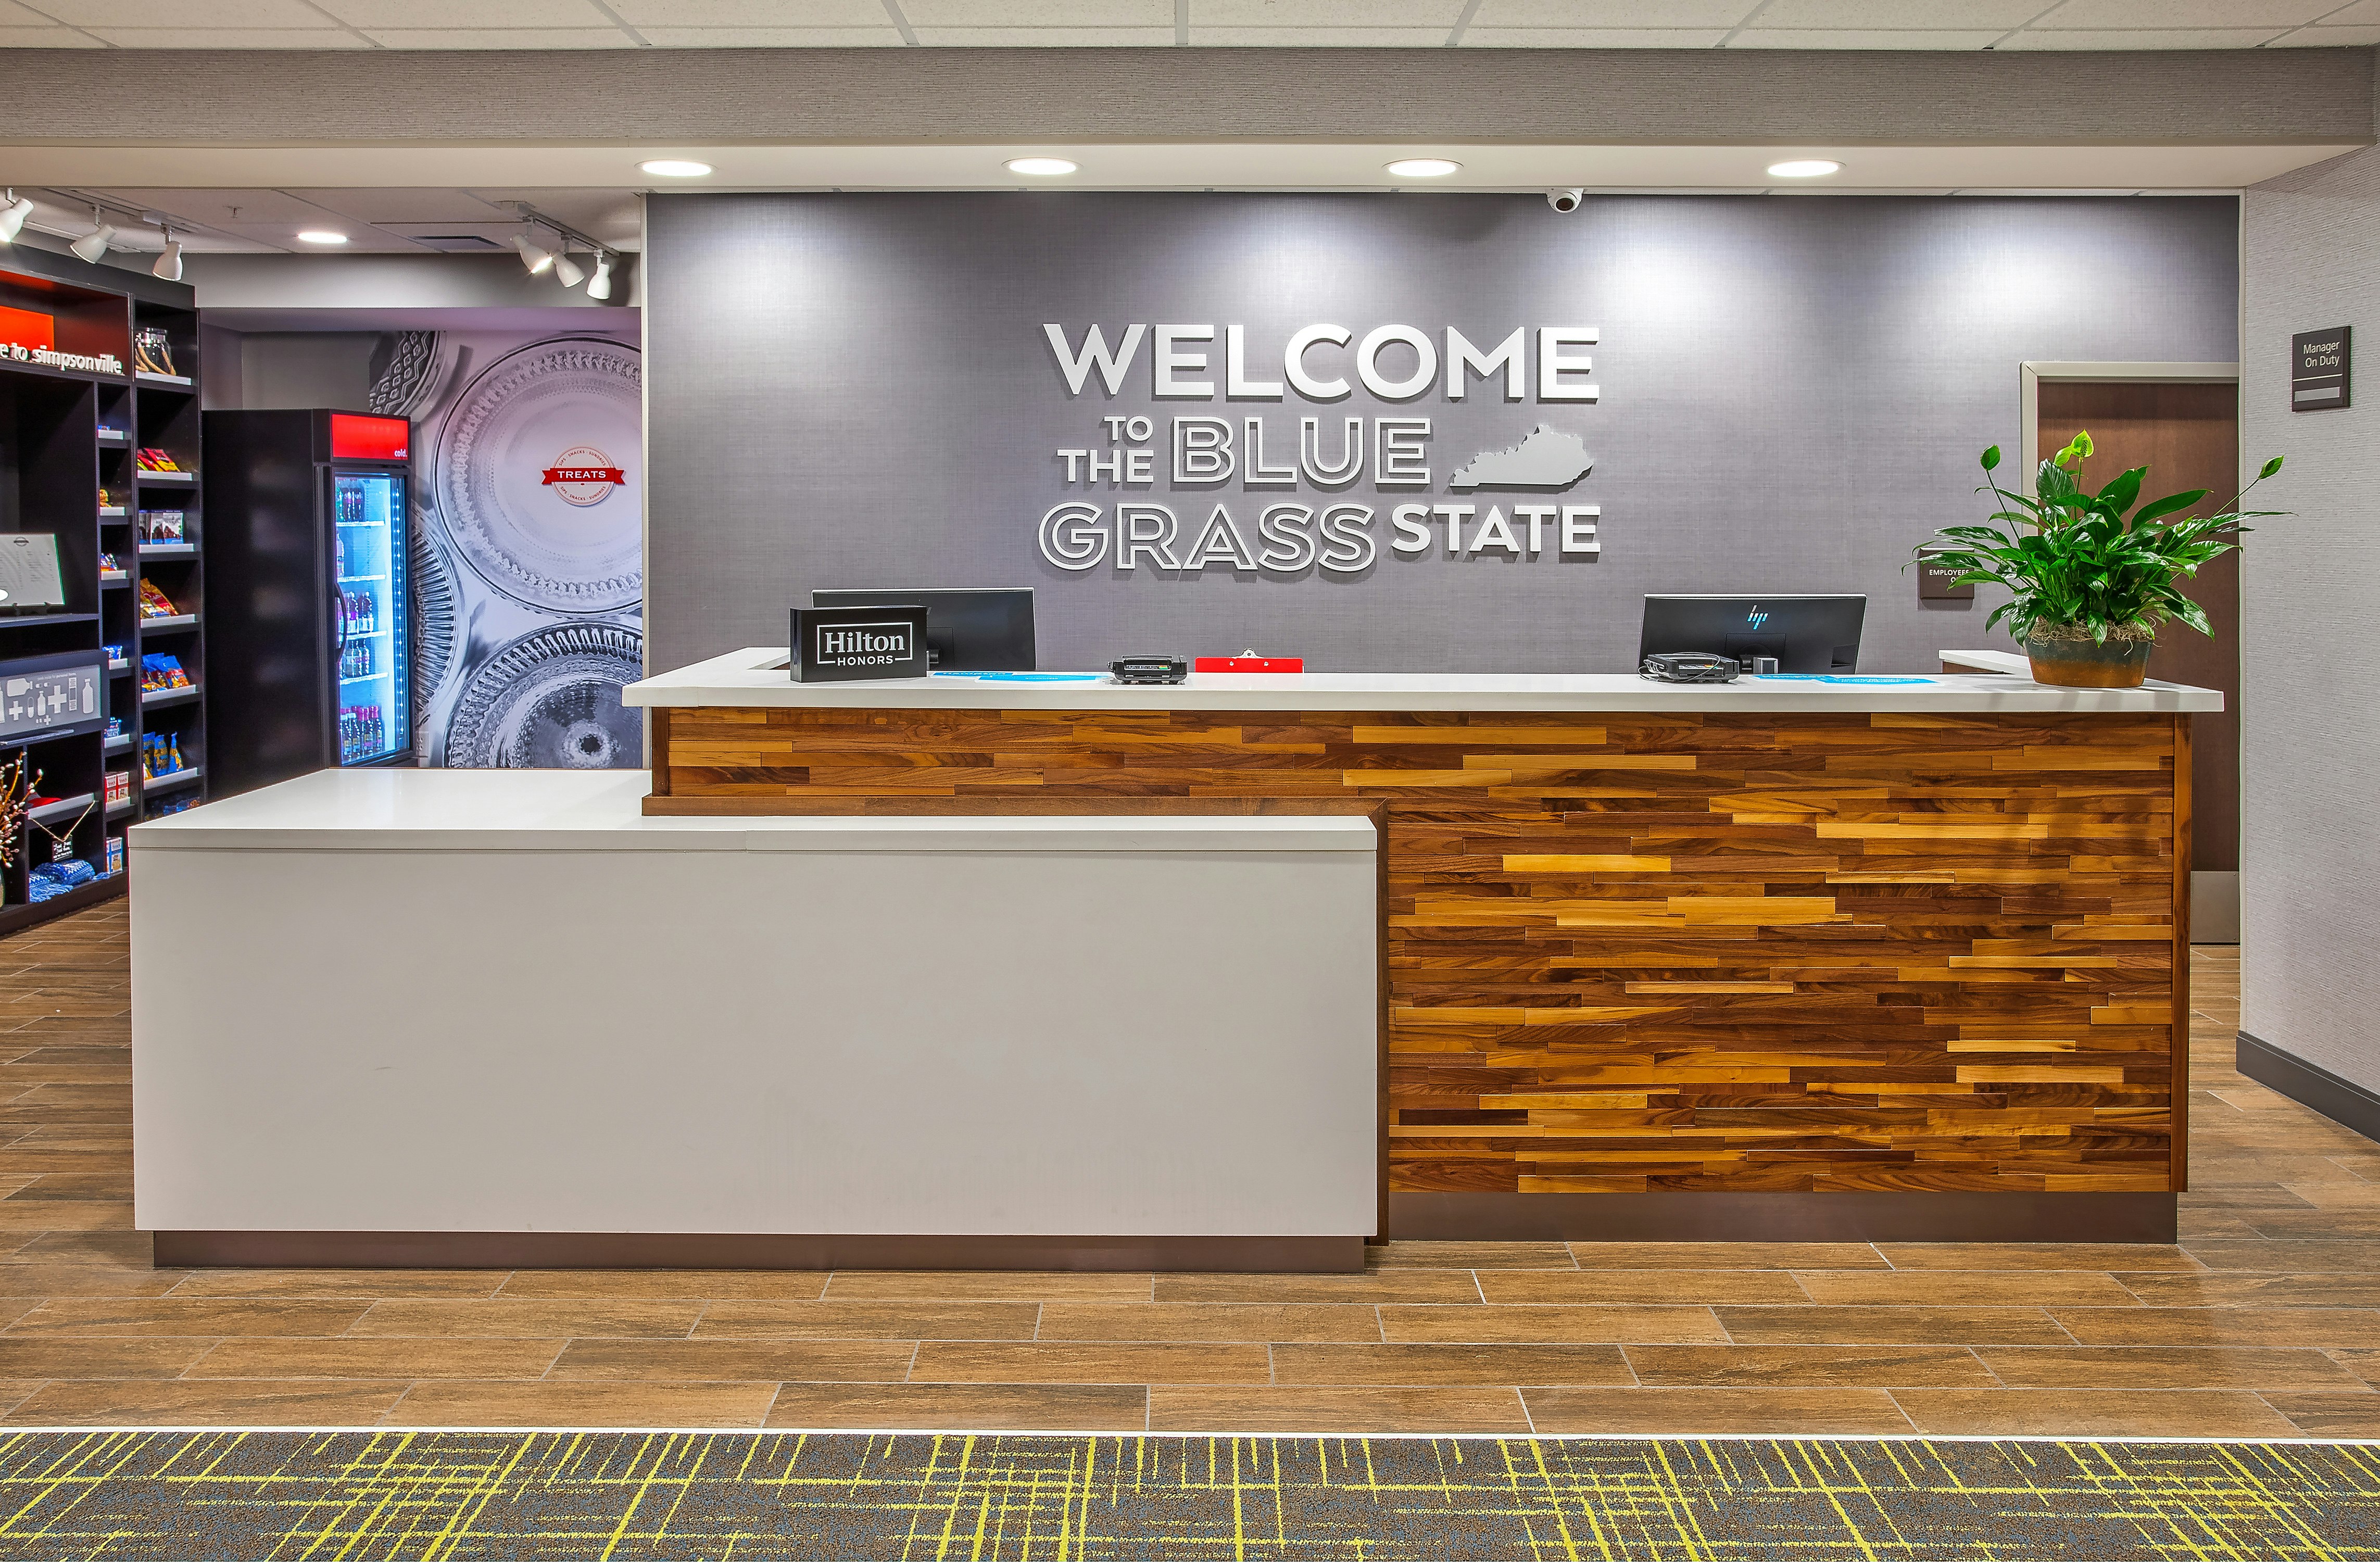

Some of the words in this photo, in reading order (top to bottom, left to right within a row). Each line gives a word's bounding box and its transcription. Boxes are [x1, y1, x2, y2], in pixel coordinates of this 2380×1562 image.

[10, 342, 28, 361] to
[32, 345, 122, 373] simpsonville
[2303, 342, 2340, 354] Manager
[1043, 323, 1600, 400] WELCOME
[2305, 358, 2317, 368] On
[2320, 355, 2340, 367] Duty
[1104, 415, 1154, 442] TO
[394, 448, 408, 457] cold.
[589, 451, 606, 465] SUNDRIES
[1174, 416, 1431, 485] BLUE
[1057, 449, 1154, 484] THE
[589, 486, 606, 499] SUNDRIES
[1038, 502, 1376, 571] GRASS
[1391, 504, 1601, 553] STATE
[1747, 605, 1768, 629] hp
[825, 632, 905, 653] Hilton
[837, 655, 893, 666] HONORS
